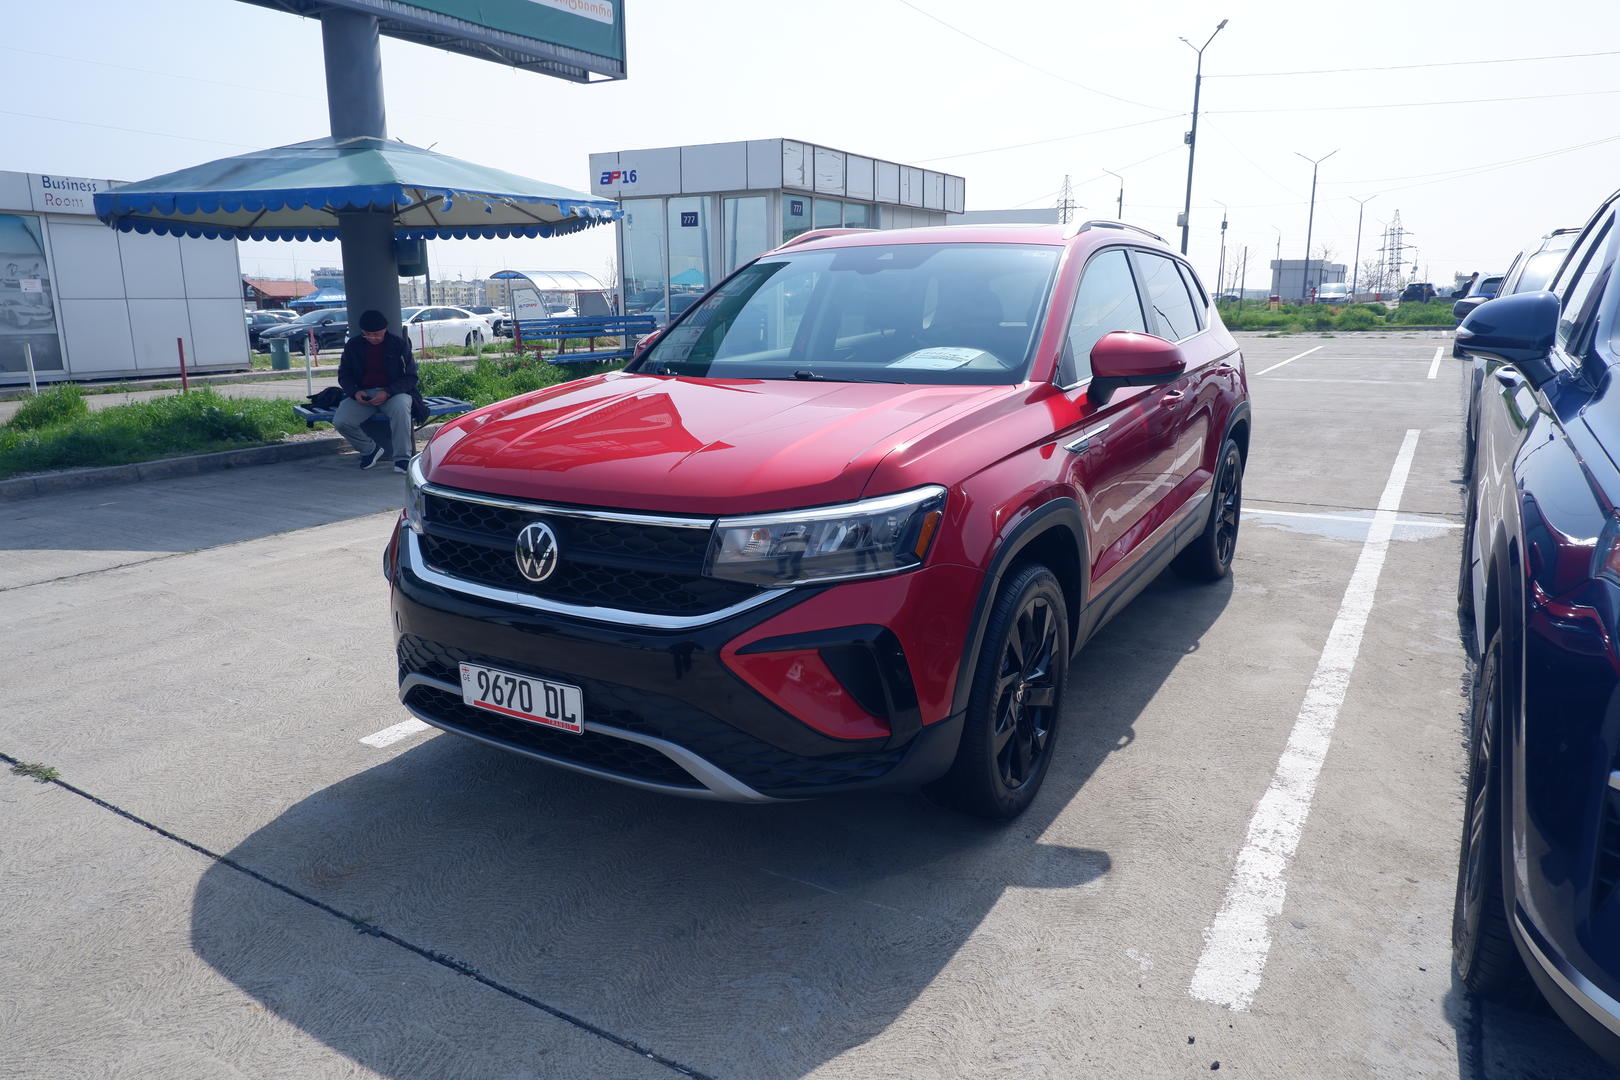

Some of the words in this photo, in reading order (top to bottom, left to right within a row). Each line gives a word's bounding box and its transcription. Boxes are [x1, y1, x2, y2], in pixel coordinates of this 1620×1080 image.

[42, 175, 97, 192] Business
[622, 169, 637, 184] 16
[45, 192, 84, 207] Room
[683, 215, 695, 224] 777
[462, 673, 471, 682] GE
[477, 670, 533, 713] 9670
[543, 682, 576, 723] DL
